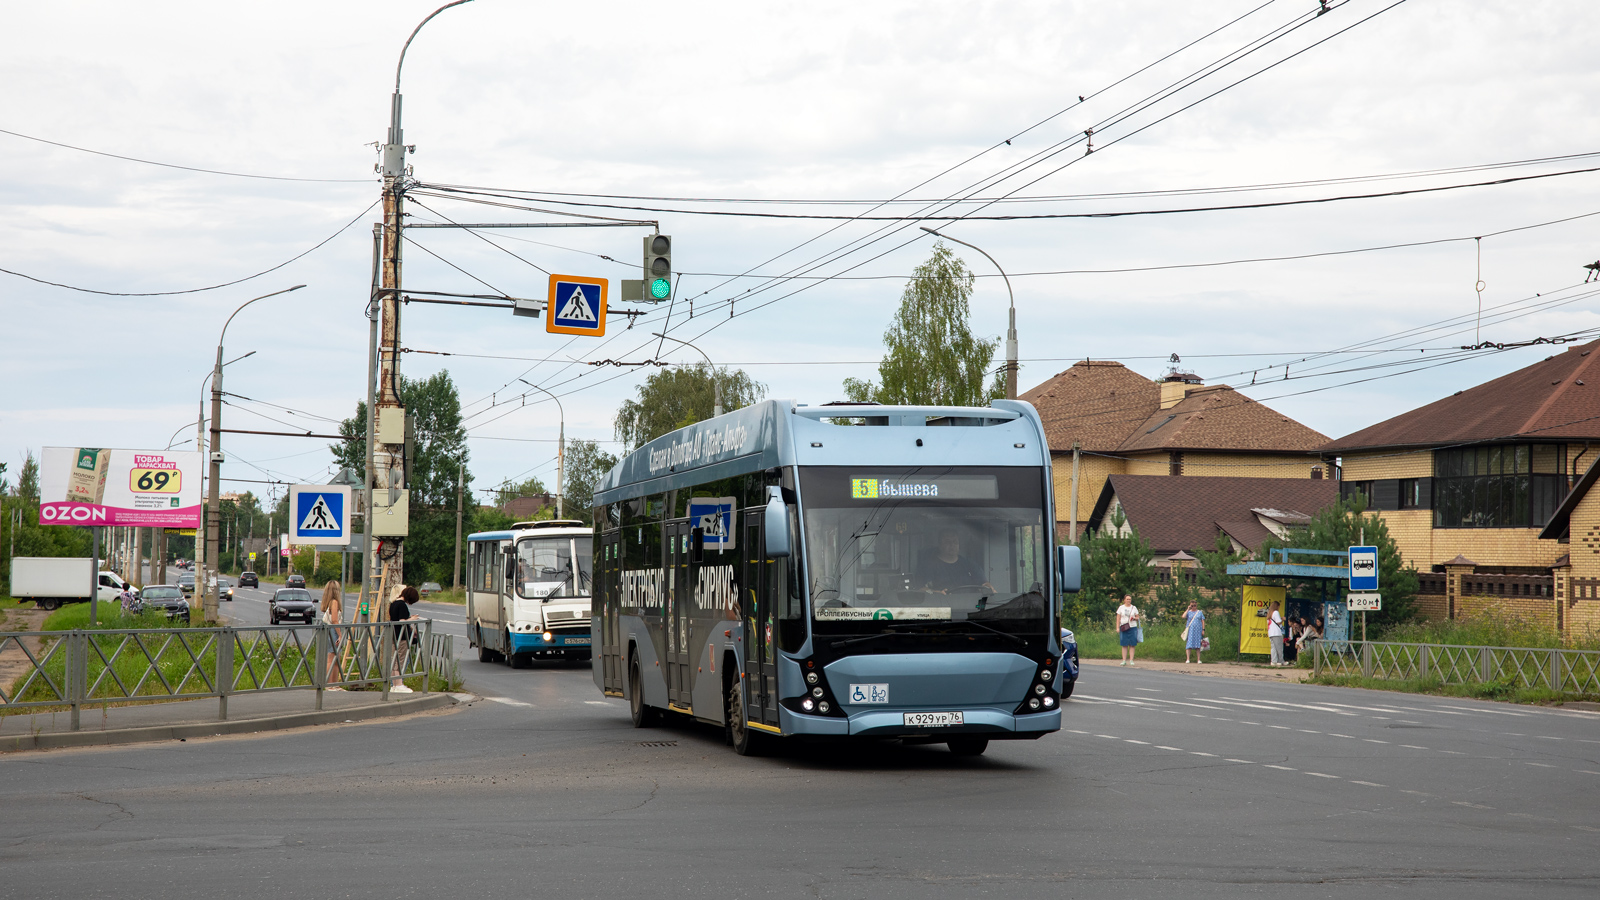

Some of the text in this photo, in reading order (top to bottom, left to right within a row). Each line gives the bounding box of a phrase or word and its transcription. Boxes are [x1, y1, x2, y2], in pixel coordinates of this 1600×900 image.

[649, 447, 667, 475] Сделан
[667, 447, 671, 467] в
[671, 440, 693, 467] Вологде
[693, 431, 702, 460] АО
[73, 471, 95, 480] МОЛОКО
[137, 471, 170, 490] 69
[42, 505, 106, 521] OZON
[620, 567, 665, 608] ЭЛЕКТРОБУС
[694, 564, 739, 611] «СИРИУС»
